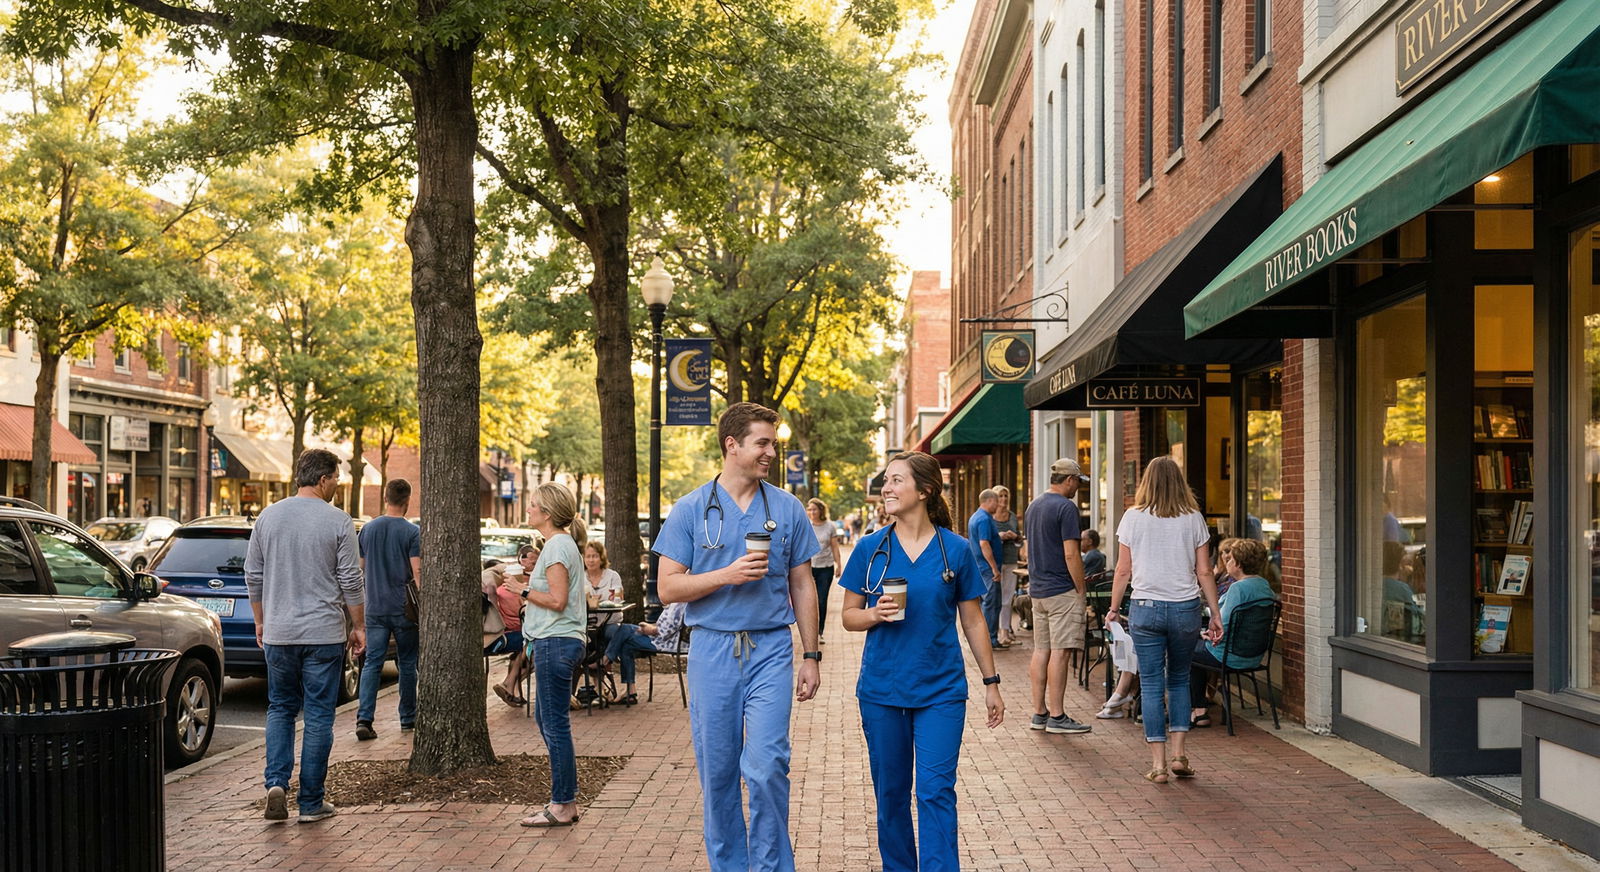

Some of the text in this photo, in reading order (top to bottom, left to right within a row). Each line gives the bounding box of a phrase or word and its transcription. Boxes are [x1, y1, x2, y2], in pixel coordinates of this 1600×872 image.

[1404, 0, 1468, 71] RIVER
[1265, 207, 1357, 292] RIVER BOOKS
[1093, 383, 1194, 401] CAFÉ LUNA
